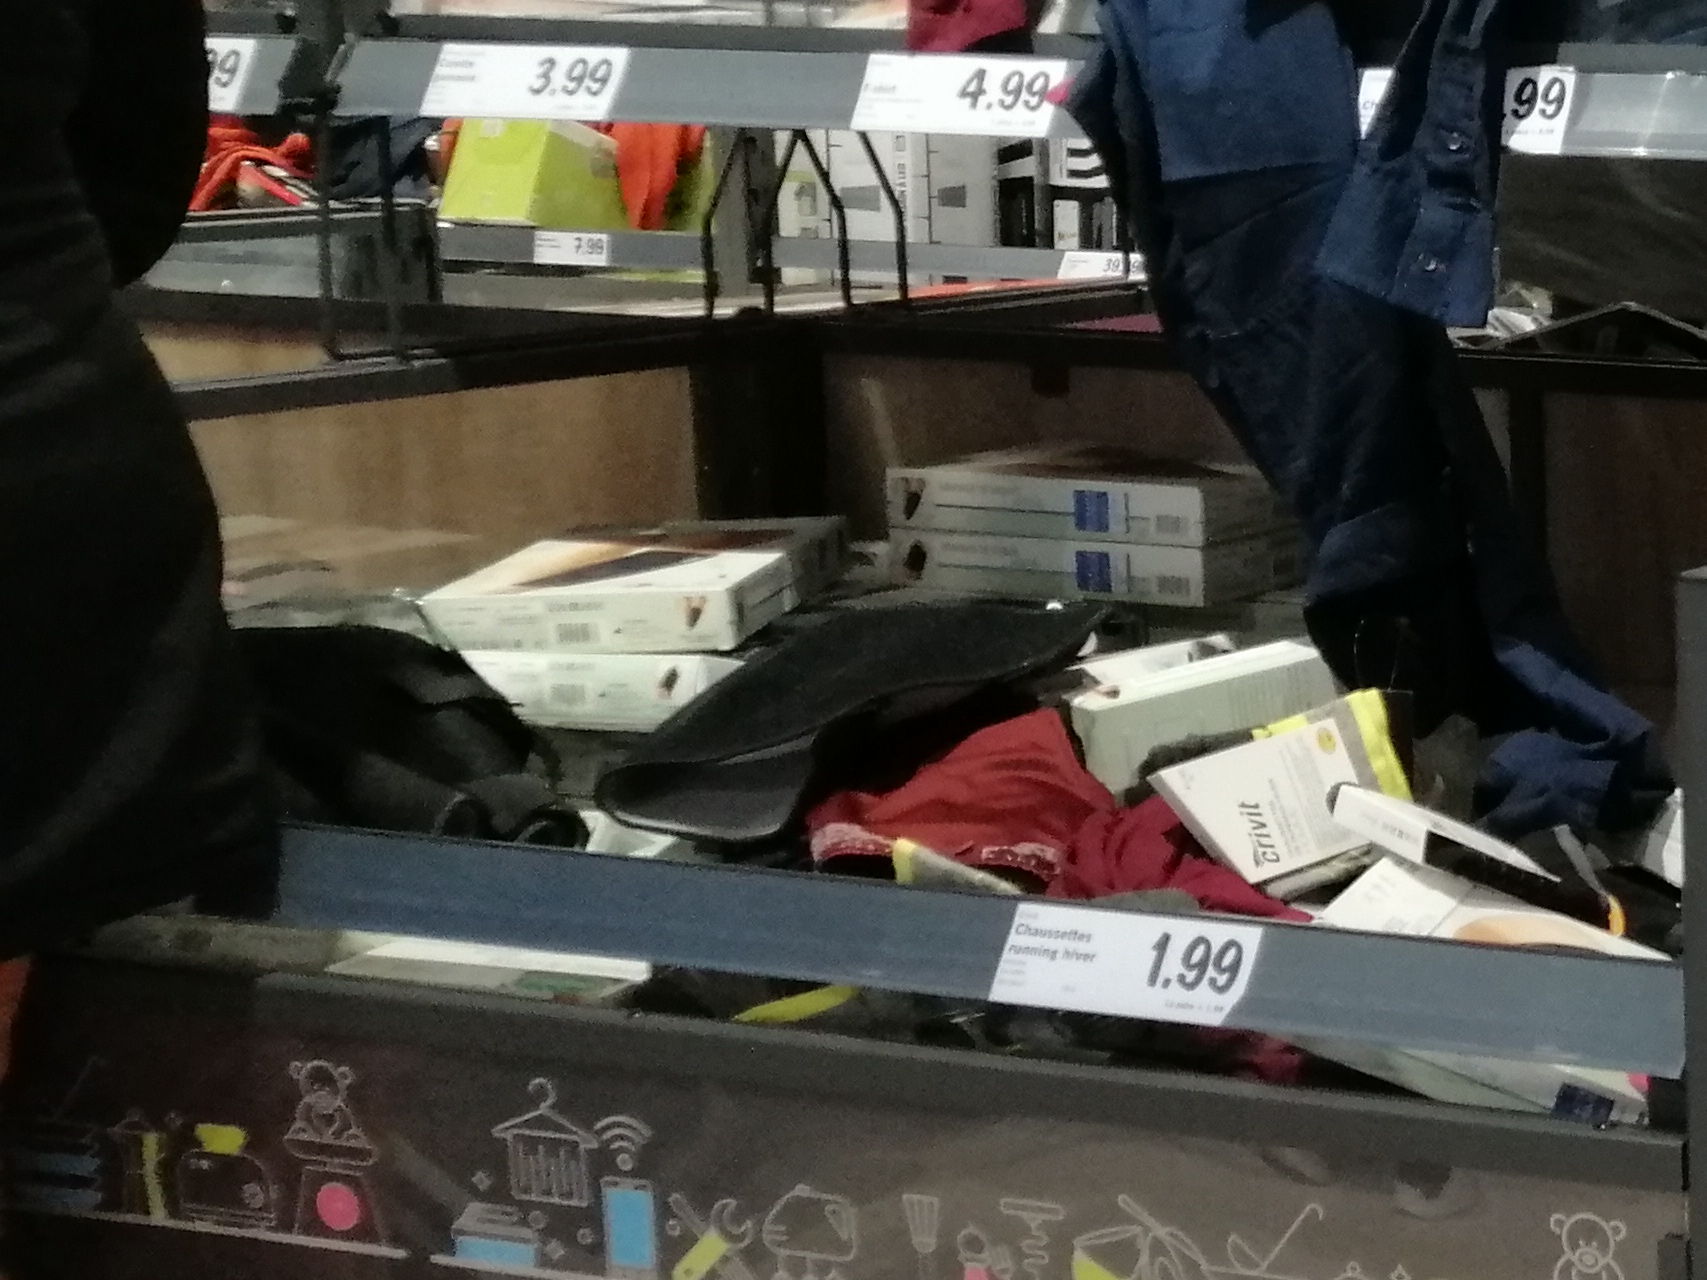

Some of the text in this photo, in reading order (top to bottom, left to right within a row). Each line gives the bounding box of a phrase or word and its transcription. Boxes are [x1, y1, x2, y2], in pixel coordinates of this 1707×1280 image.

[528, 56, 613, 97] 3.99
[957, 67, 1050, 111] 4.99
[1238, 800, 1281, 868] crivit
[1007, 943, 1097, 963] running hiver
[1014, 923, 1092, 944] Chaussettes
[1146, 931, 1244, 995] 1.99
